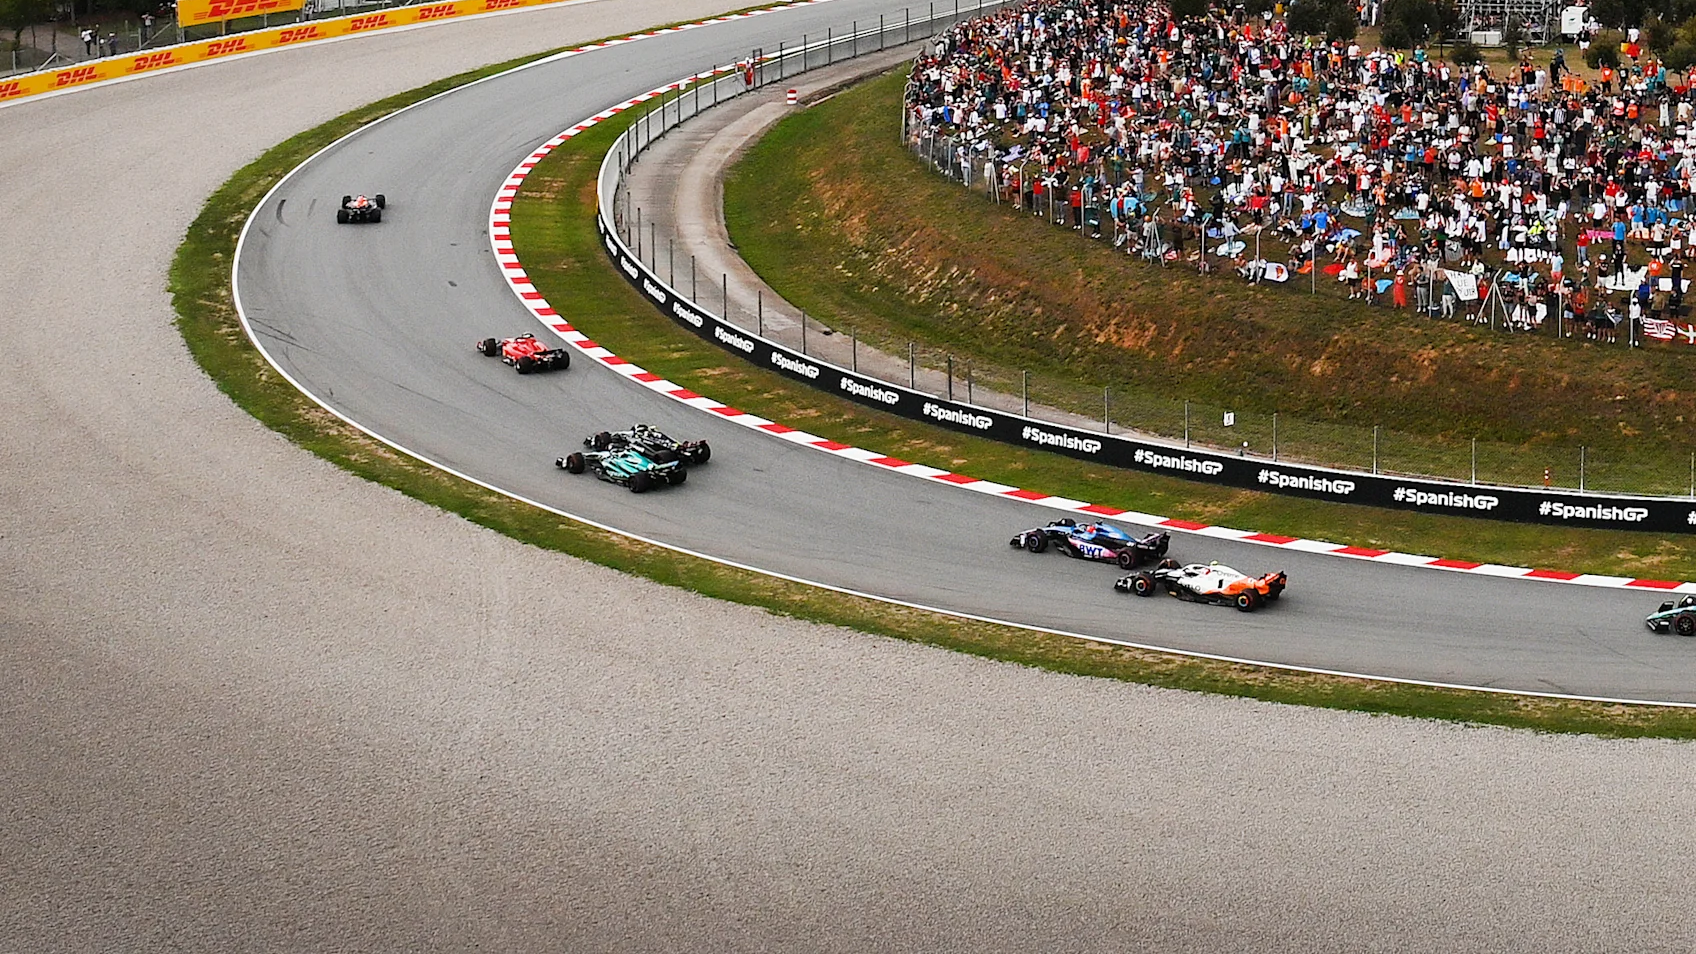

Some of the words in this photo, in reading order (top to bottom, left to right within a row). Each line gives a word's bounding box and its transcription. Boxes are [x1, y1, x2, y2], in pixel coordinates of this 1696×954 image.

[351, 14, 389, 32] DHL
[419, 3, 457, 20] DHL
[279, 25, 319, 44] DHL
[207, 38, 248, 57] DHL
[134, 52, 175, 71] DHL
[56, 66, 98, 87] DHL
[771, 352, 820, 379] #SpanishGP
[841, 377, 900, 405] #SpanishGP
[923, 402, 993, 430] #SpanishGP
[1023, 425, 1102, 454] #SpanishGP
[1134, 448, 1224, 476] #SpanishGP
[1258, 468, 1355, 495] #SpanishGP
[1393, 486, 1499, 511] #SpanishGP
[1539, 501, 1649, 523] #SpanishGP
